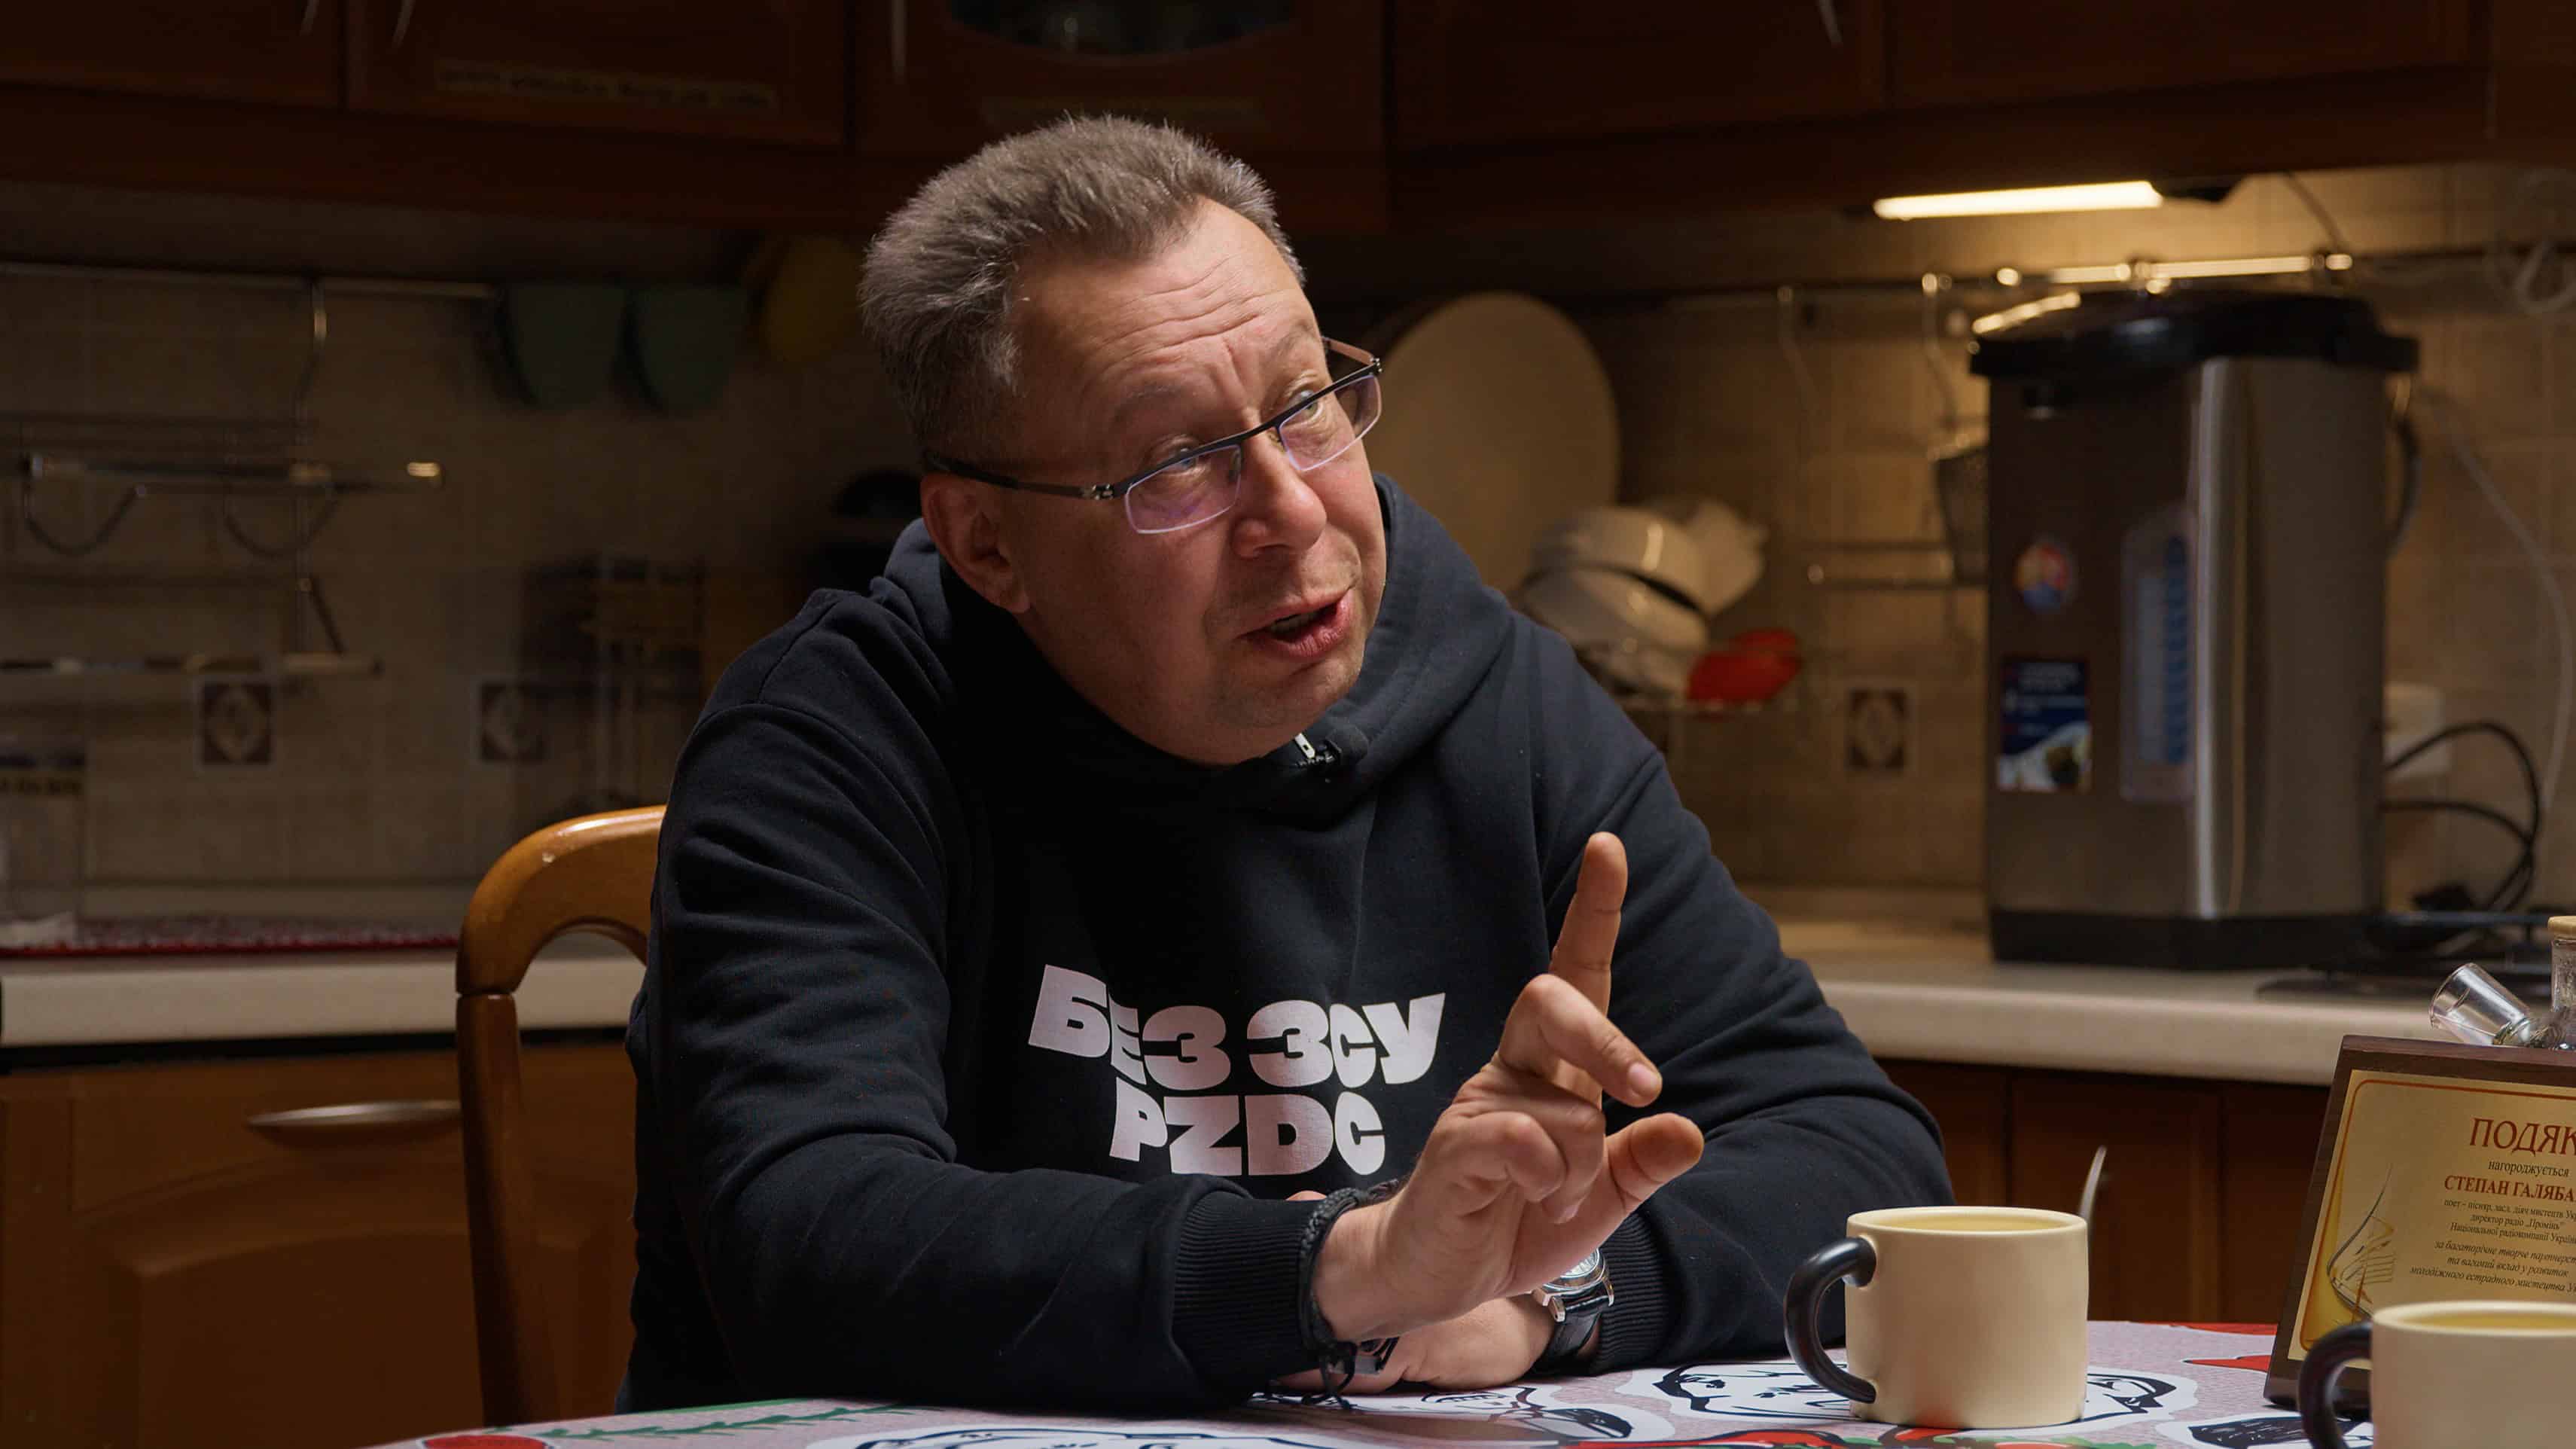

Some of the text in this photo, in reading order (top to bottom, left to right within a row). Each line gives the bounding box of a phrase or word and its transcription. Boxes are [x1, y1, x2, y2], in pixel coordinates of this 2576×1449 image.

[1028, 964, 1446, 1091] БЕЗ ЗСУ
[1109, 1077, 1386, 1176] PZDC
[2444, 1175, 2576, 1202] СТЕПАН ГАЛЯБА
[2488, 1161, 2569, 1177] нагороджується
